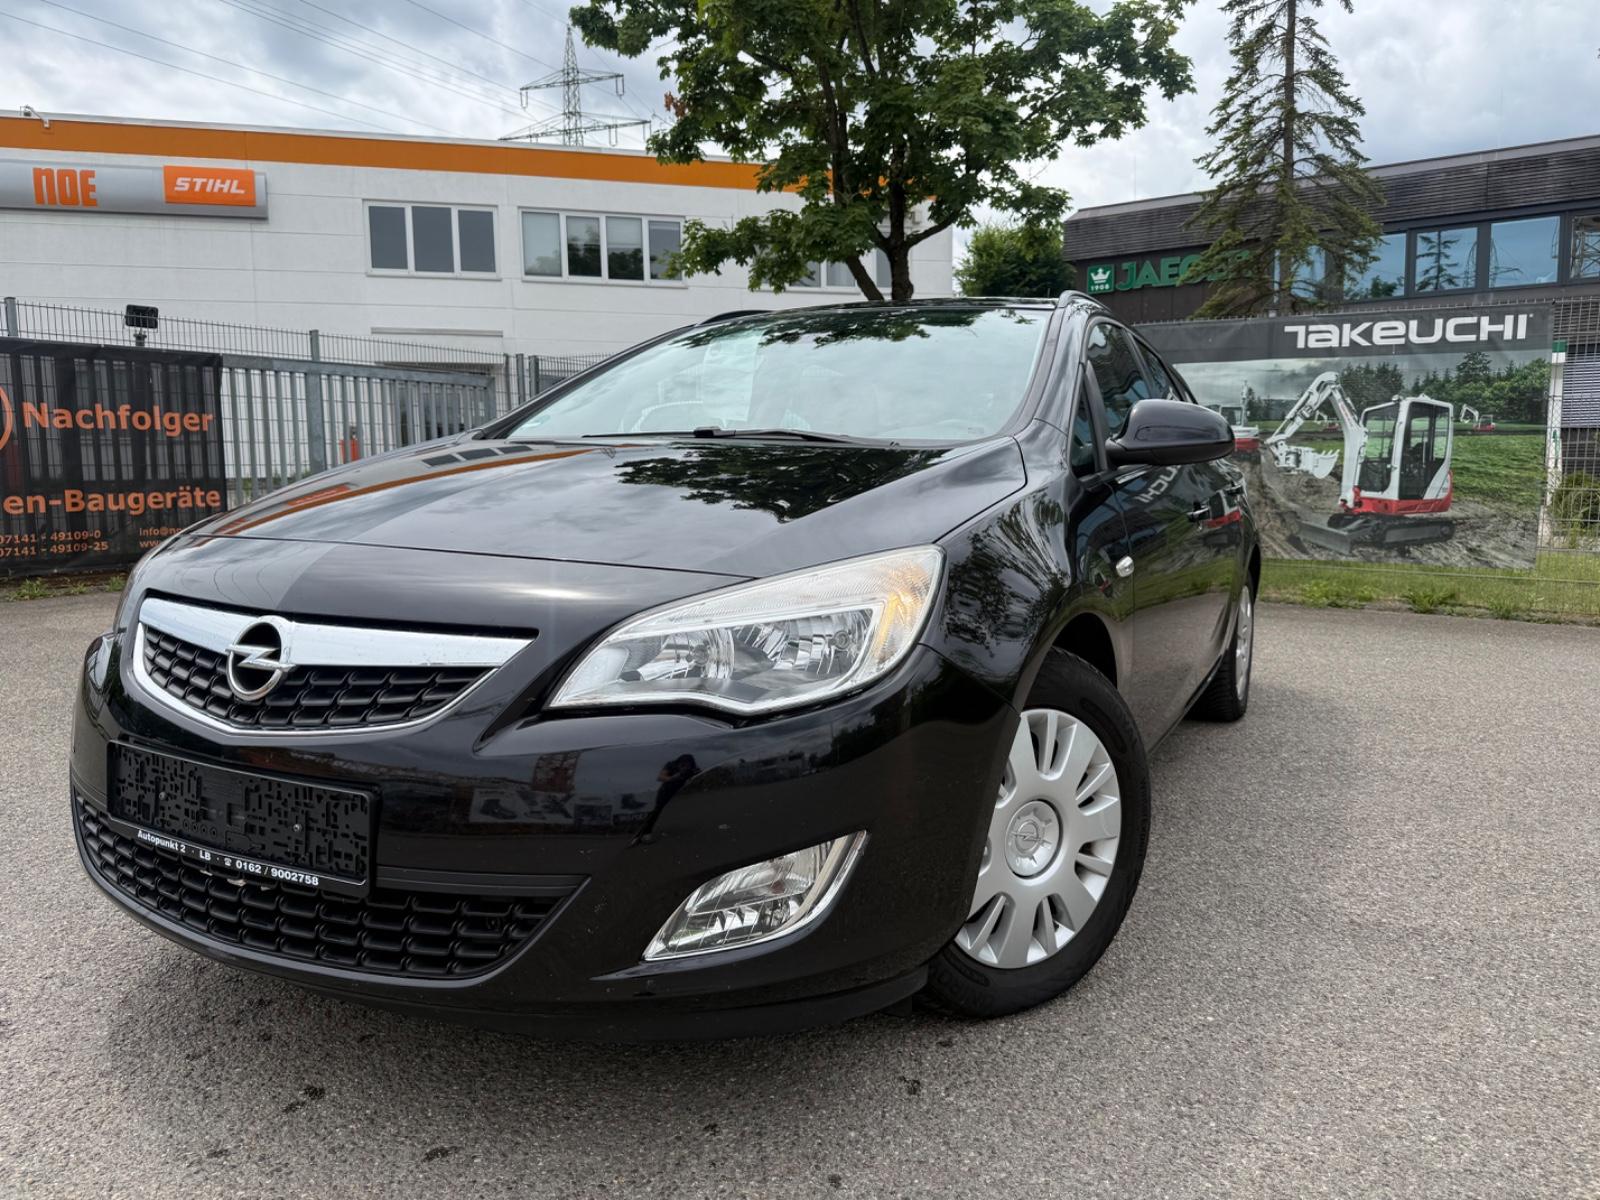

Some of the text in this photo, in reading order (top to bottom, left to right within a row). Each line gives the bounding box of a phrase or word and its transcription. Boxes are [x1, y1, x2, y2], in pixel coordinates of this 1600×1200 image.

[174, 176, 246, 195] STIHL
[1116, 249, 1253, 291] JAEG
[22, 402, 214, 437] Nachfolger
[3, 486, 221, 515] en-Baugeräte
[50, 529, 102, 541] 49109-0
[50, 541, 109, 553] 49109-25
[138, 829, 178, 851] Autopunkt
[180, 844, 186, 853] 2
[199, 849, 211, 861] LB
[235, 860, 262, 874] 0162
[270, 868, 319, 886] 9002758
